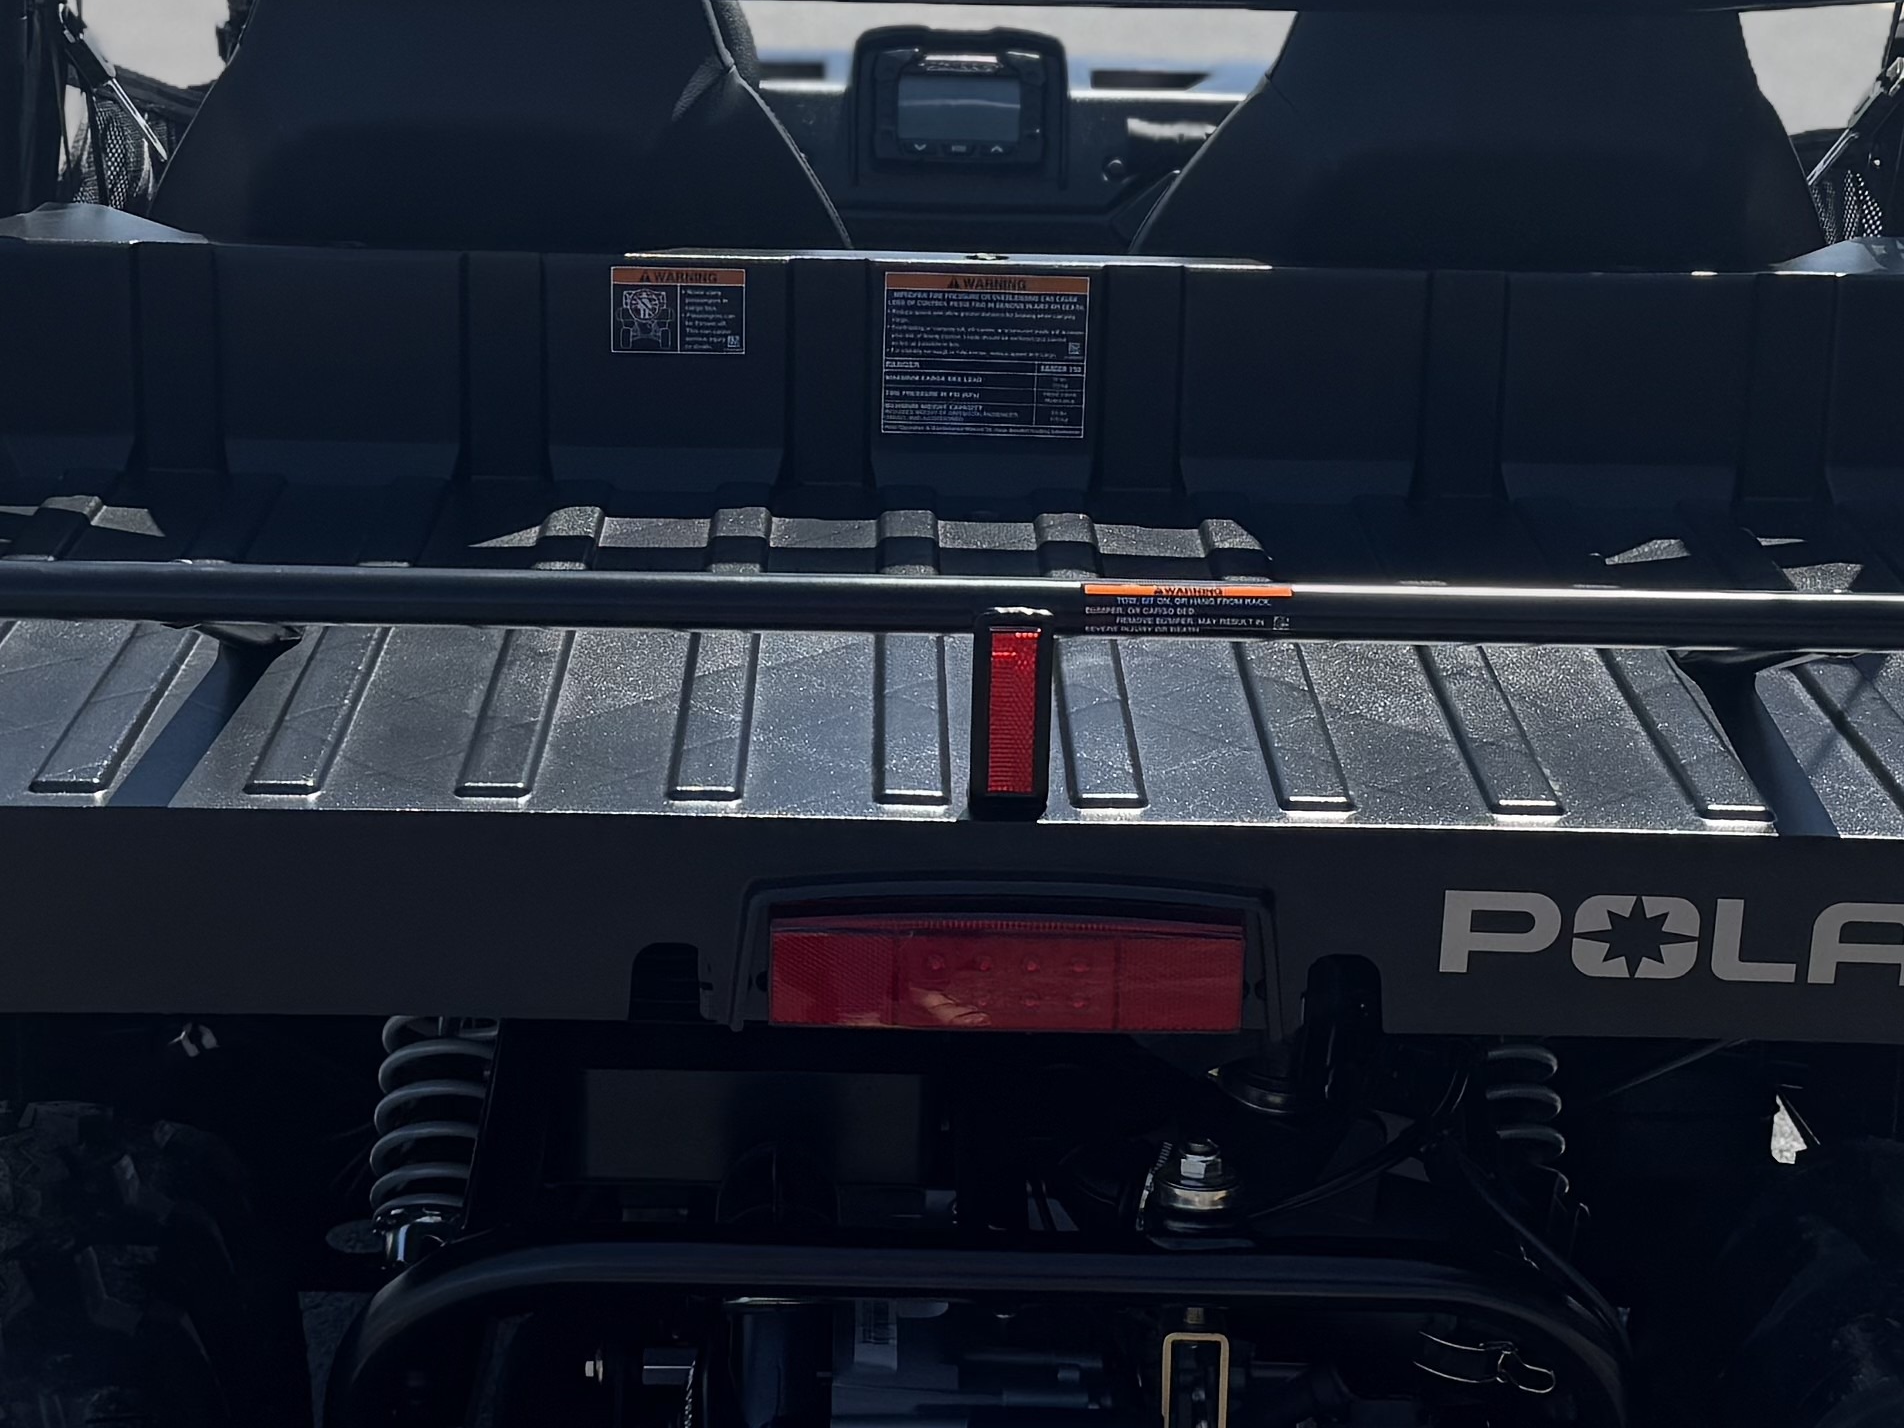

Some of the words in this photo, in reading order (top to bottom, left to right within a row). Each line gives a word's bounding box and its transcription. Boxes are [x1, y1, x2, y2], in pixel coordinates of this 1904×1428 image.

[654, 271, 718, 283] WARNING
[963, 278, 1027, 290] WARNING
[1163, 587, 1223, 596] WARNING
